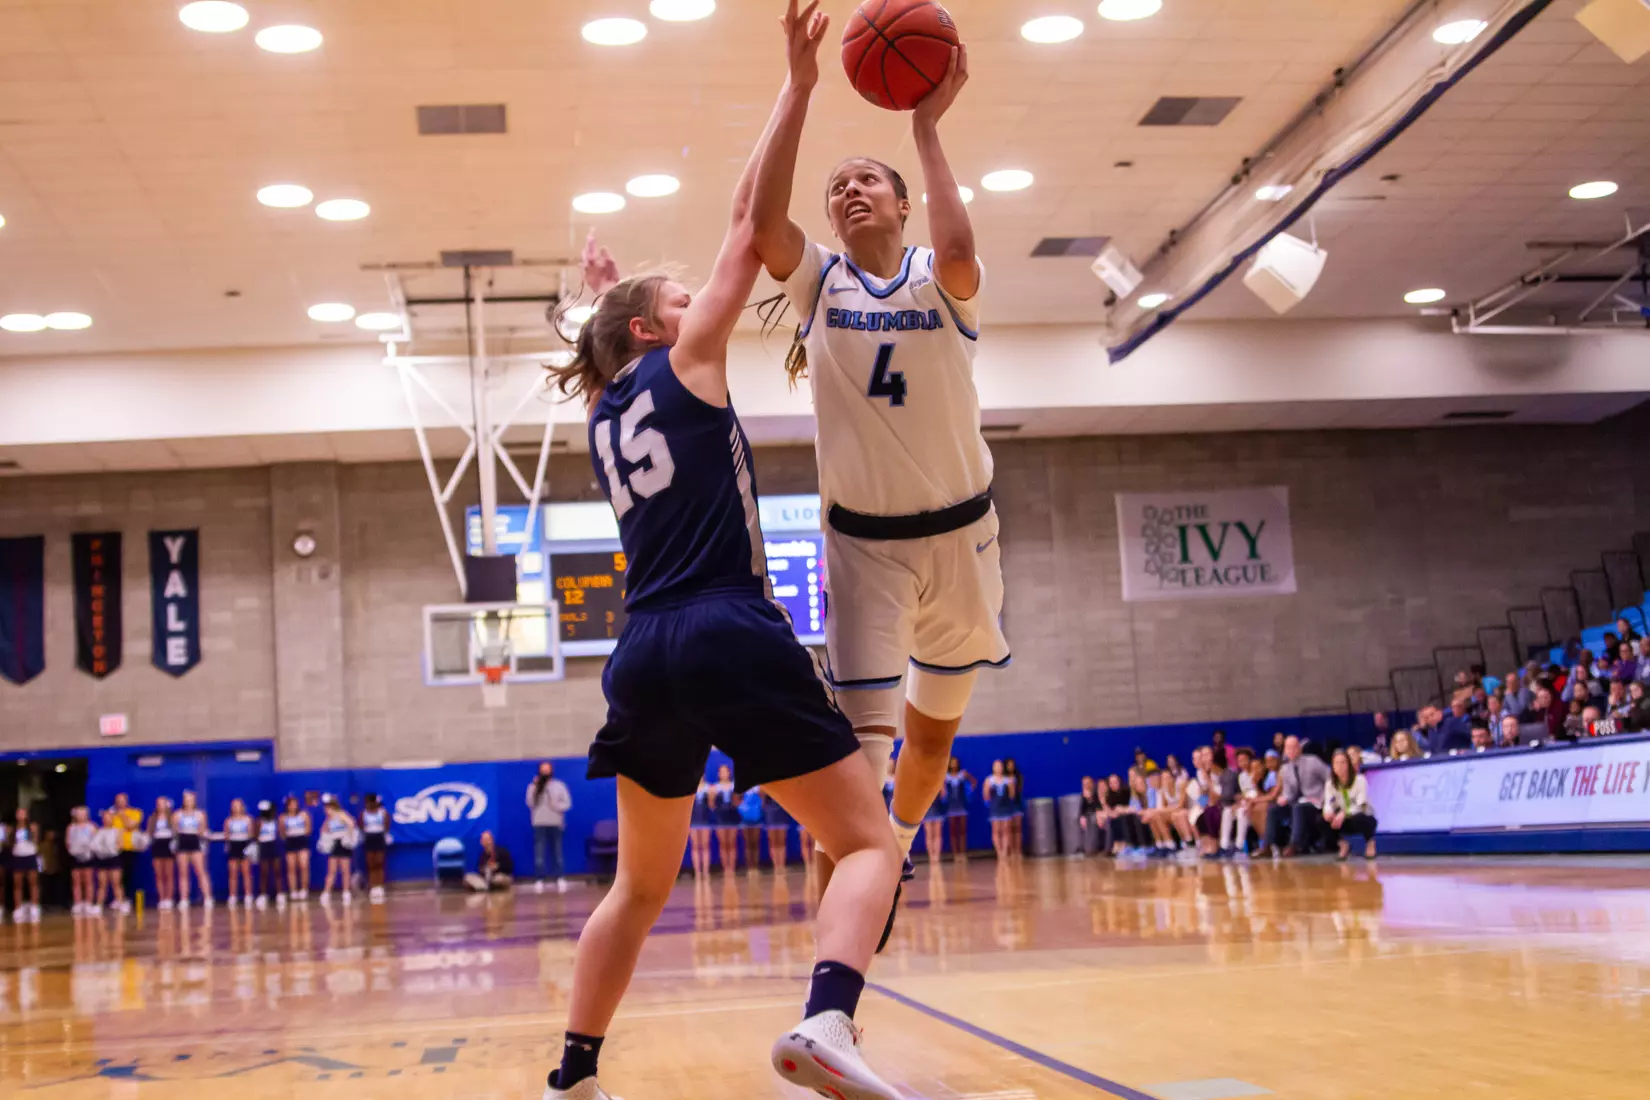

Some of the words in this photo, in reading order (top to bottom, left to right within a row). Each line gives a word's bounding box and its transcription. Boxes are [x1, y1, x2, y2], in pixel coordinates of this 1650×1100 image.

[826, 307, 944, 332] COLUMBIA
[867, 342, 908, 407] 4
[594, 389, 676, 521] 15
[1175, 504, 1209, 520] THE
[1175, 519, 1266, 565] IVY
[1177, 563, 1272, 588] LEAGUE
[162, 535, 188, 666] YALE
[563, 589, 585, 605] 12
[1499, 772, 1526, 800] GET
[1527, 767, 1572, 800] BACK
[1570, 764, 1602, 796] THE
[1602, 761, 1641, 794] LIFE
[393, 794, 472, 824] SNY
